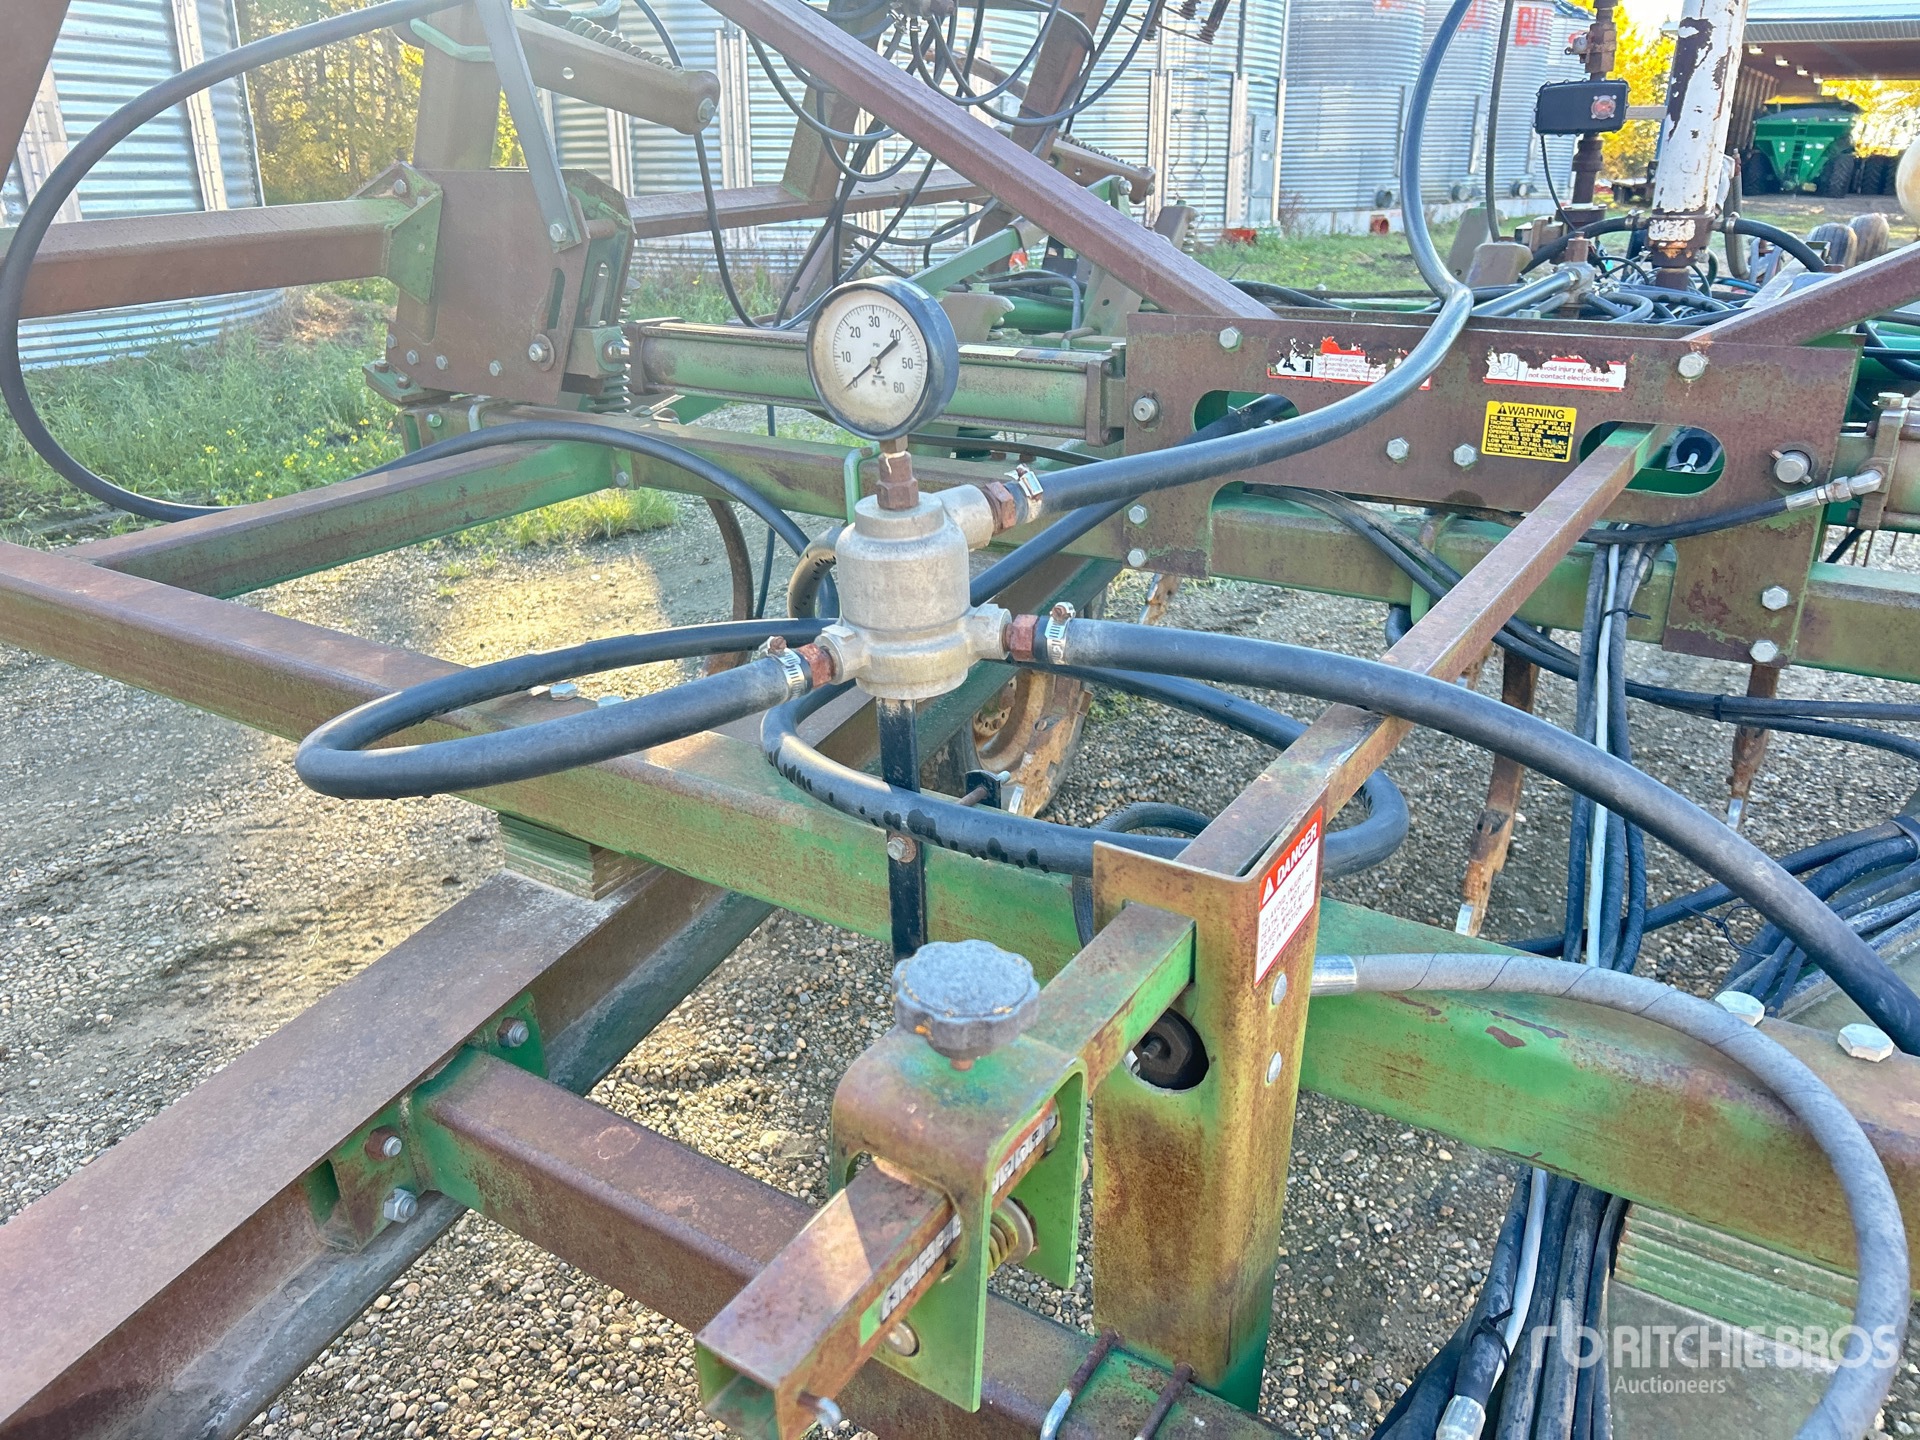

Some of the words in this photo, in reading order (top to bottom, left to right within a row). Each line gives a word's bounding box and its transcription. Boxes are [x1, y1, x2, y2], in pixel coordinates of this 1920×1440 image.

[868, 316, 880, 328] 30
[850, 326, 861, 338] 20
[890, 330, 901, 342] 40
[841, 351, 852, 363] 10
[902, 358, 914, 370] 50
[894, 382, 904, 394] 60
[1507, 406, 1565, 419] WARNING
[1276, 822, 1318, 886] DANGER
